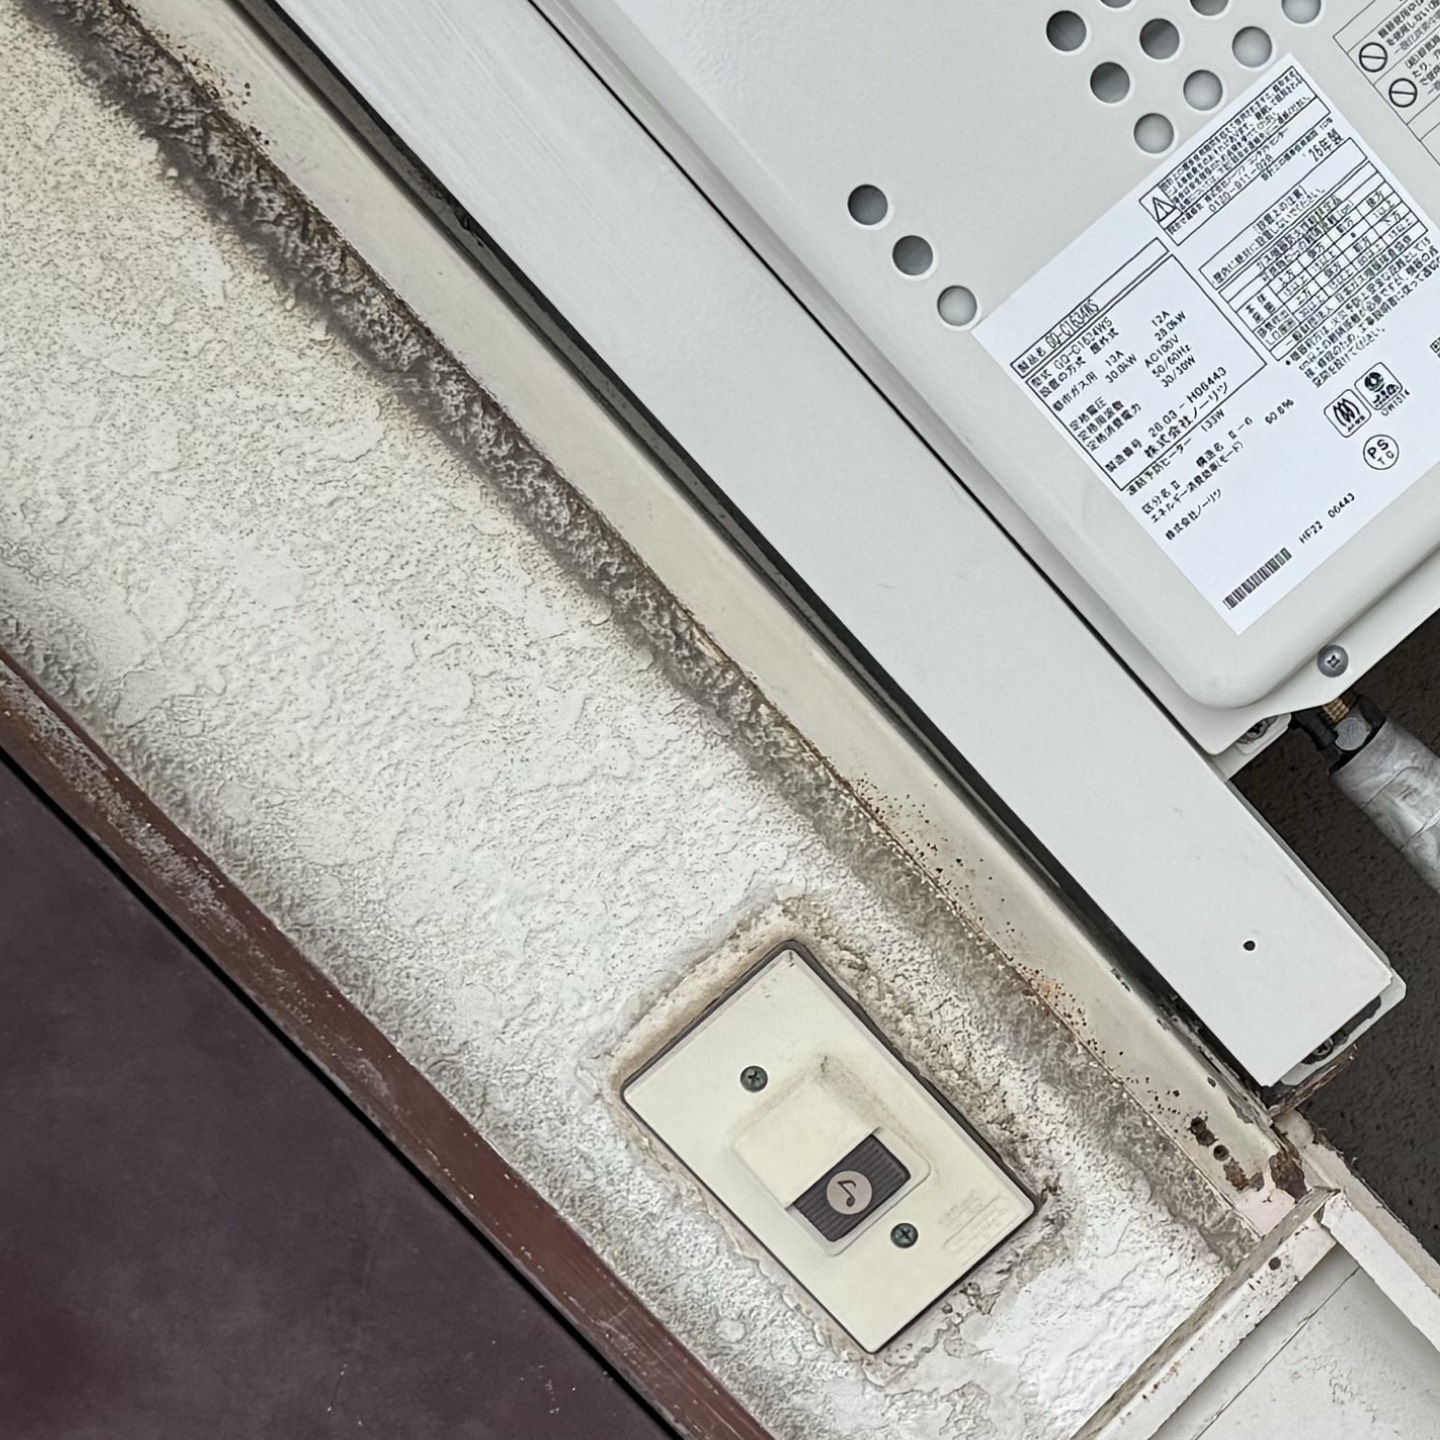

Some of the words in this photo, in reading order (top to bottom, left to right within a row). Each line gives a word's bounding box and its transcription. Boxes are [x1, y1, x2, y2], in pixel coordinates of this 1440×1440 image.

[1142, 332, 1181, 368] AC100V
[1142, 379, 1232, 459] 株式会社ノーリツ
[1164, 487, 1223, 540] 株式会社ノーリツ
